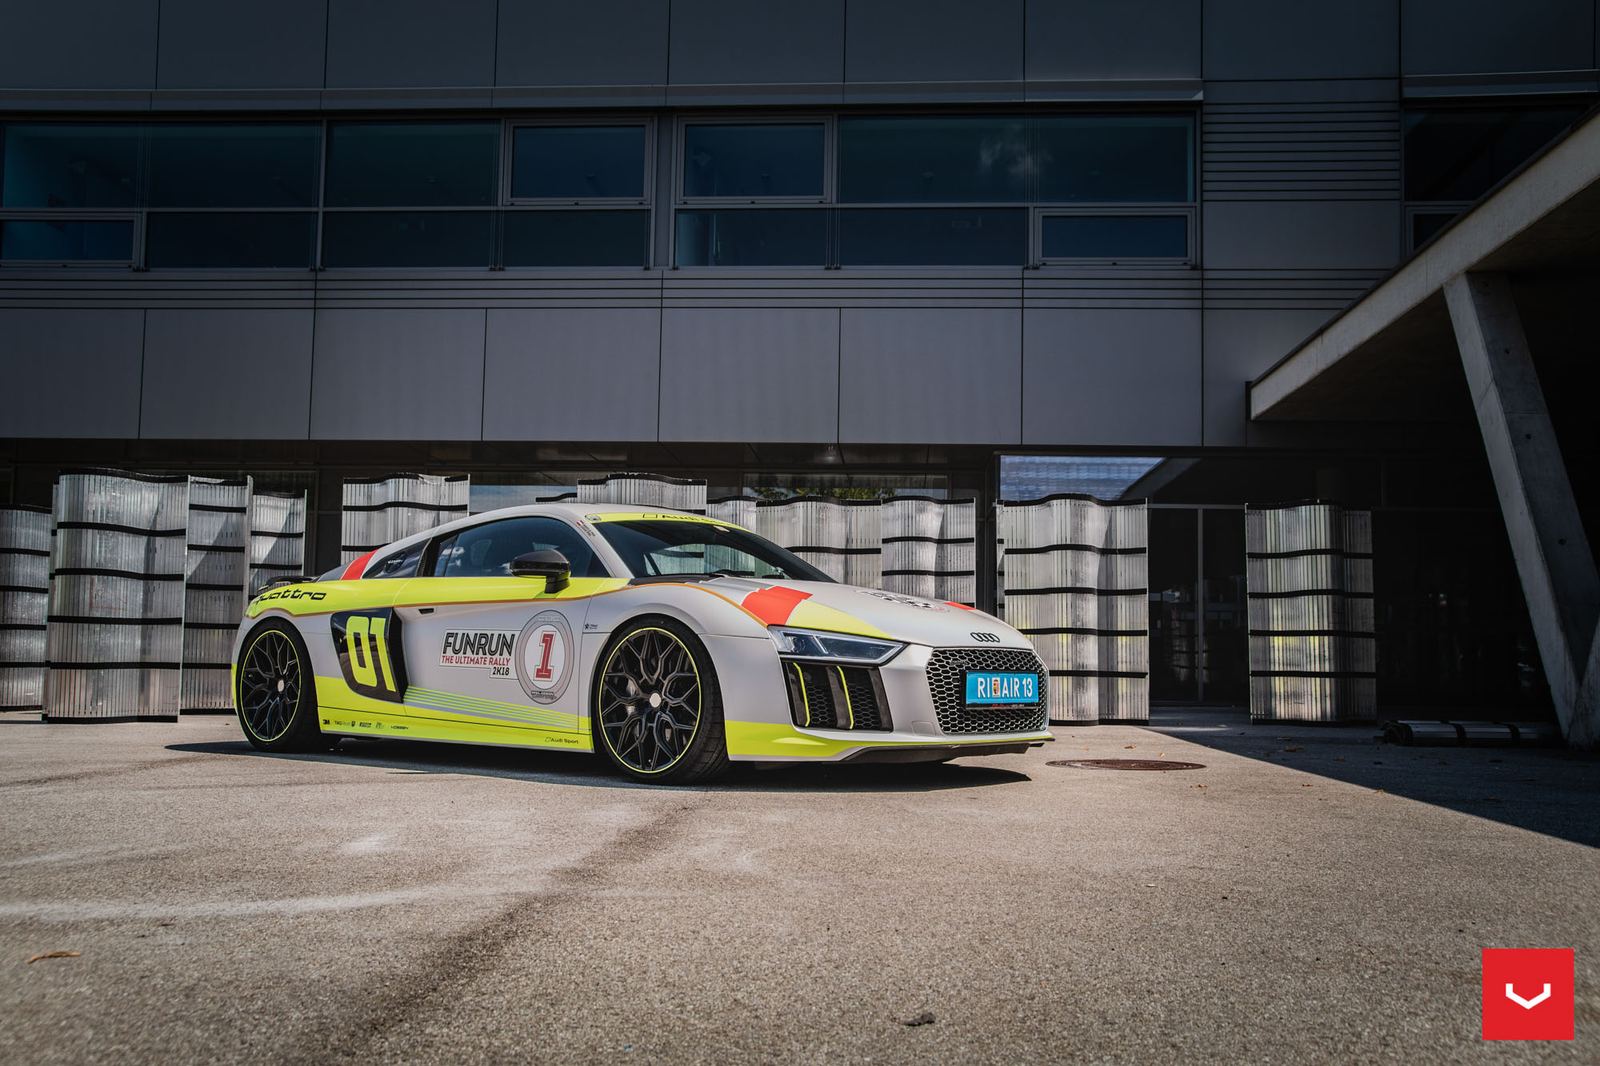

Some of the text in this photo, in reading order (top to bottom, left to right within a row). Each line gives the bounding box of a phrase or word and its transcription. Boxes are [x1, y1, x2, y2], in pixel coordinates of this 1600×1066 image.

[346, 615, 396, 692] 01
[442, 632, 516, 657] FUNRUN
[535, 632, 555, 680] 1
[441, 655, 511, 666] THE ULTIMATE RALLY
[492, 666, 510, 676] 2K18
[977, 677, 1033, 698] RI AIR 13
